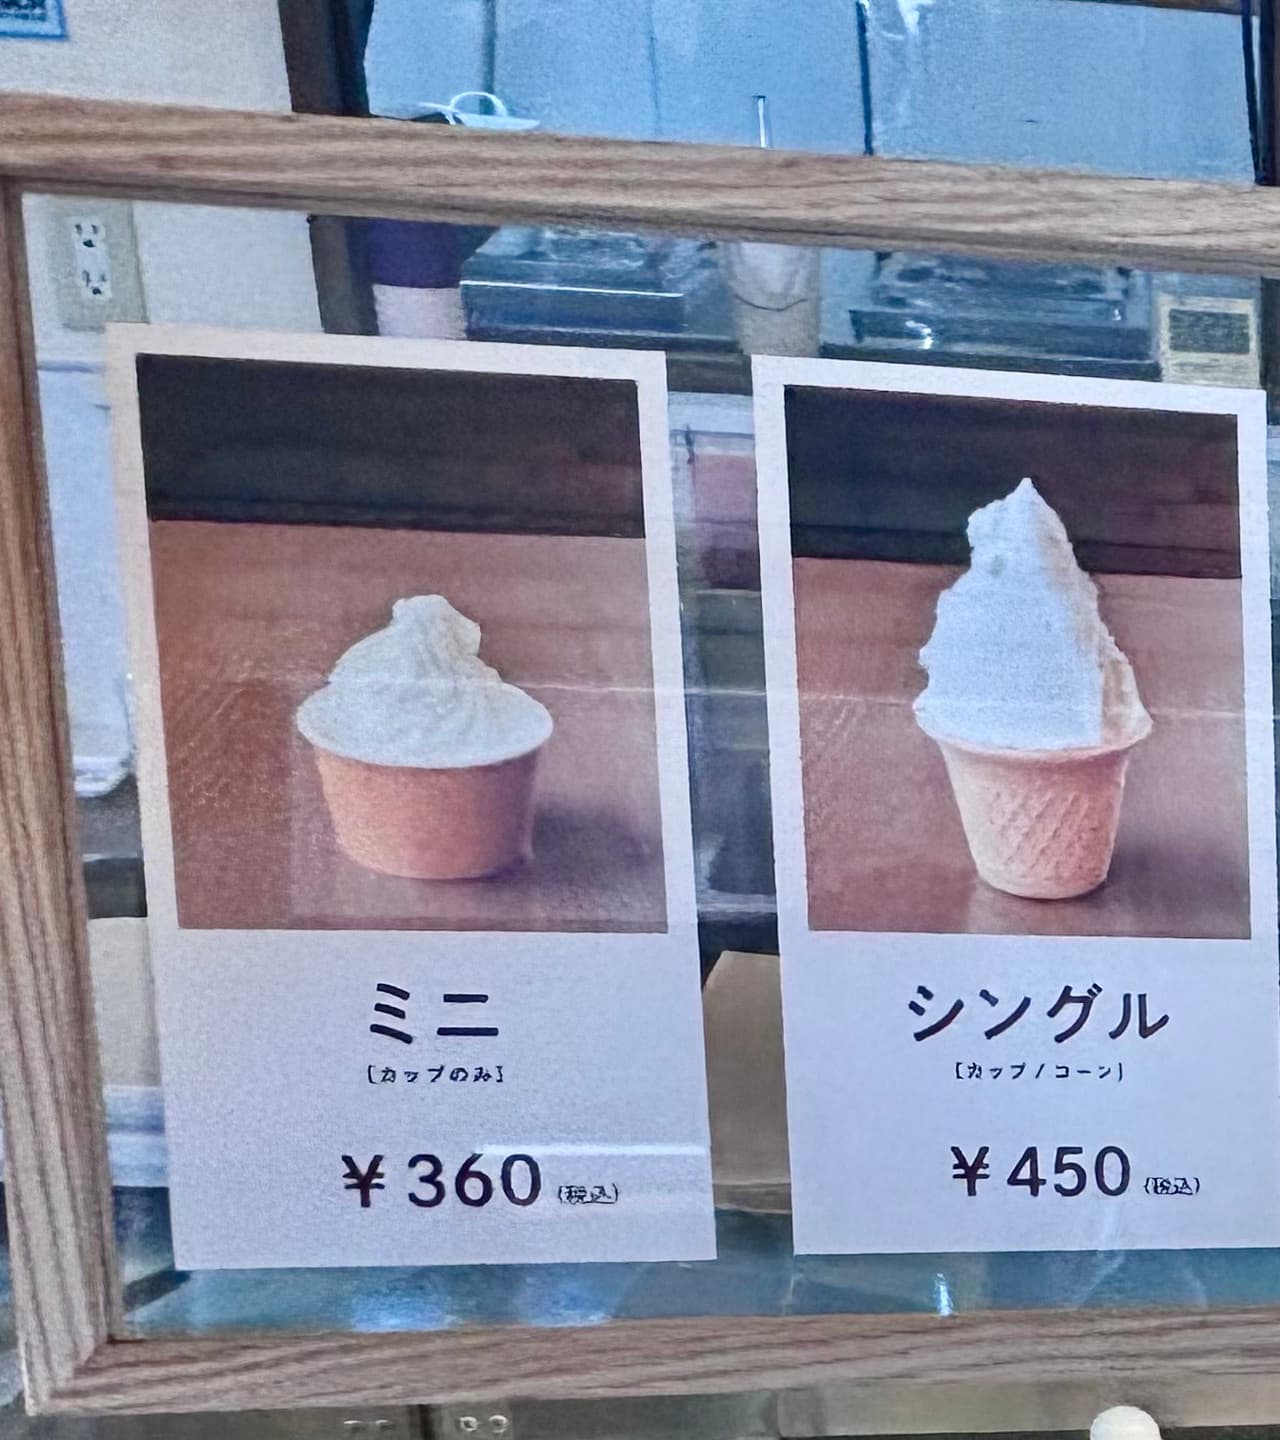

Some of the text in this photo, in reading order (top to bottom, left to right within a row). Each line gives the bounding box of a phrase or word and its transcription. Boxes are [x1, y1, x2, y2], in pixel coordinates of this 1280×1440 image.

[369, 982, 500, 1045] ミニ
[907, 982, 1170, 1044] シングル
[341, 1152, 542, 1208] ¥360
[950, 1144, 1131, 1197] ¥450
